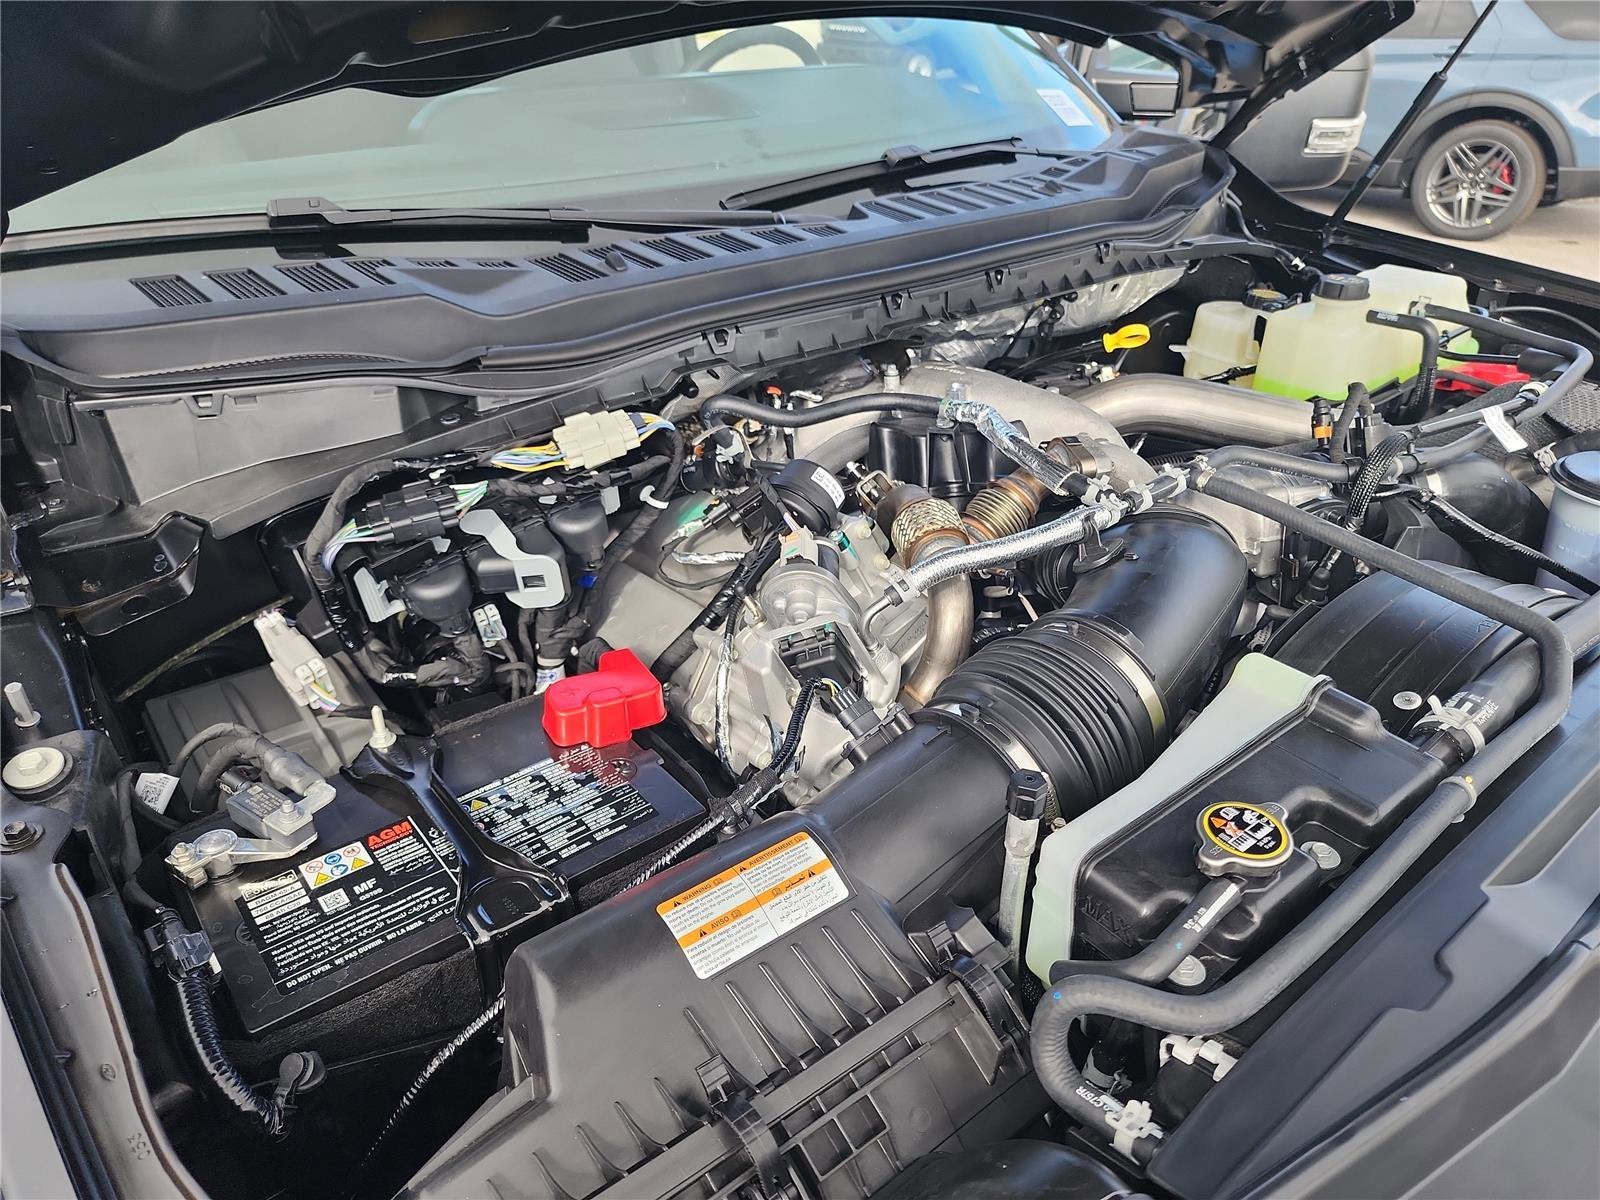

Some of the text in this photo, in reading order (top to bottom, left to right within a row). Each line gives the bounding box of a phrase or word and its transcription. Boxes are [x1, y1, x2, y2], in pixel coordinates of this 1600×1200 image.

[368, 821, 411, 846] AGM
[748, 839, 795, 866] AVERTISSEMENT
[352, 877, 376, 894] MF
[681, 883, 713, 901] WARNING
[710, 915, 729, 929] AVISO
[285, 979, 297, 988] DO
[296, 971, 311, 982] NOT
[311, 963, 333, 975] OPEN.
[343, 950, 358, 960] PAS
[357, 938, 385, 953] OUVRIR.
[385, 931, 397, 940] NO
[395, 927, 406, 936] LA
[405, 919, 425, 931] ABRA.
